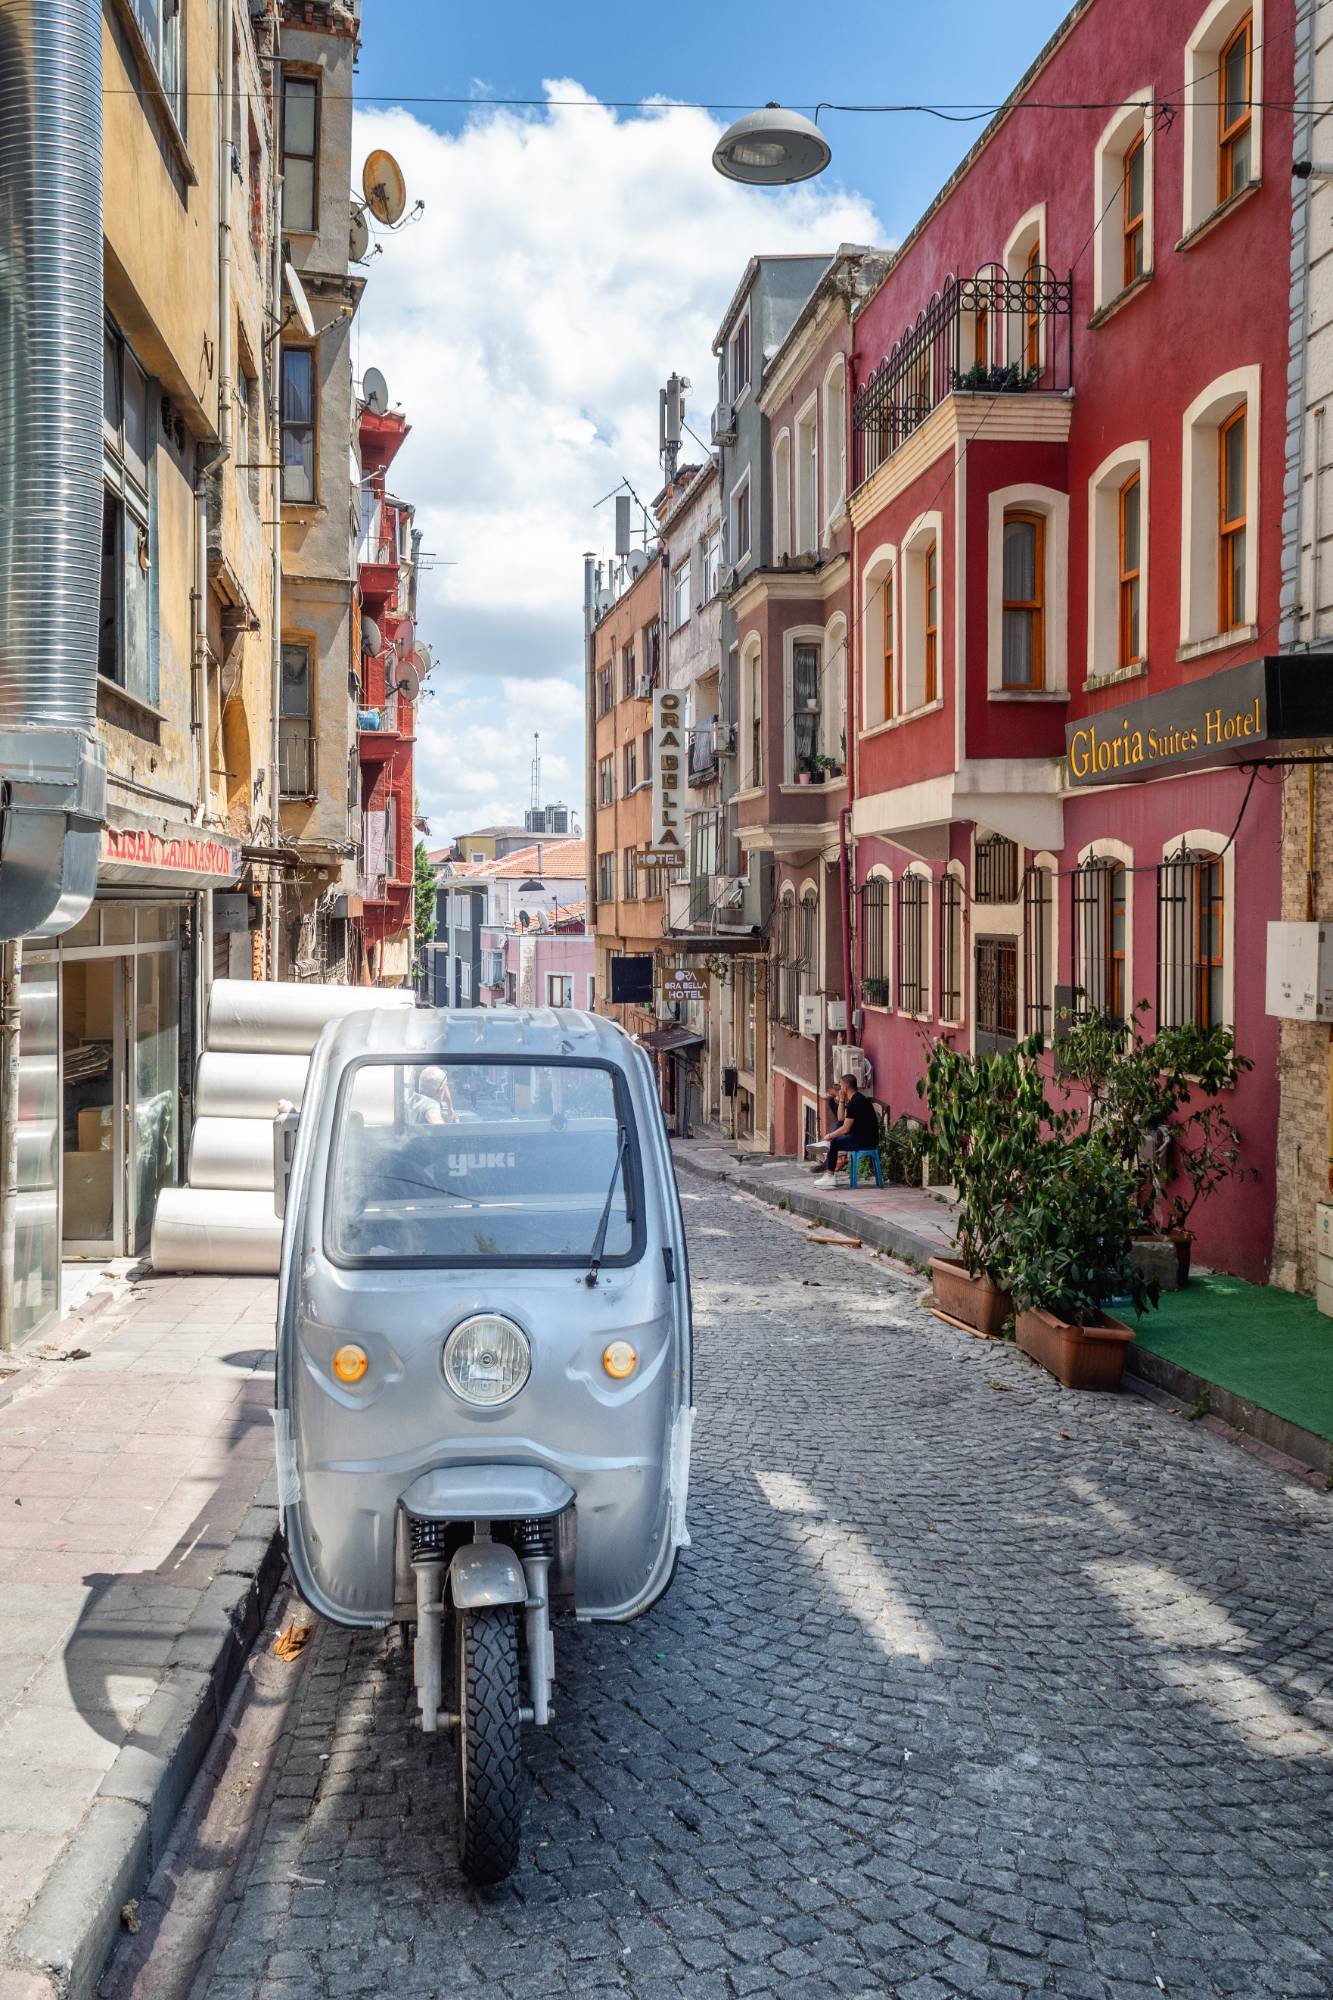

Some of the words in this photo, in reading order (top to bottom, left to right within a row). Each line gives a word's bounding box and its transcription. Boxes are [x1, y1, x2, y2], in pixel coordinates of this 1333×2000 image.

[1070, 719, 1144, 778] Gloria
[1148, 724, 1199, 760] Suites
[1205, 697, 1261, 746] Hotel
[636, 853, 683, 866] HOTEL
[664, 982, 682, 990] ORA
[682, 981, 708, 990] BELLA
[668, 990, 704, 999] HOTEL
